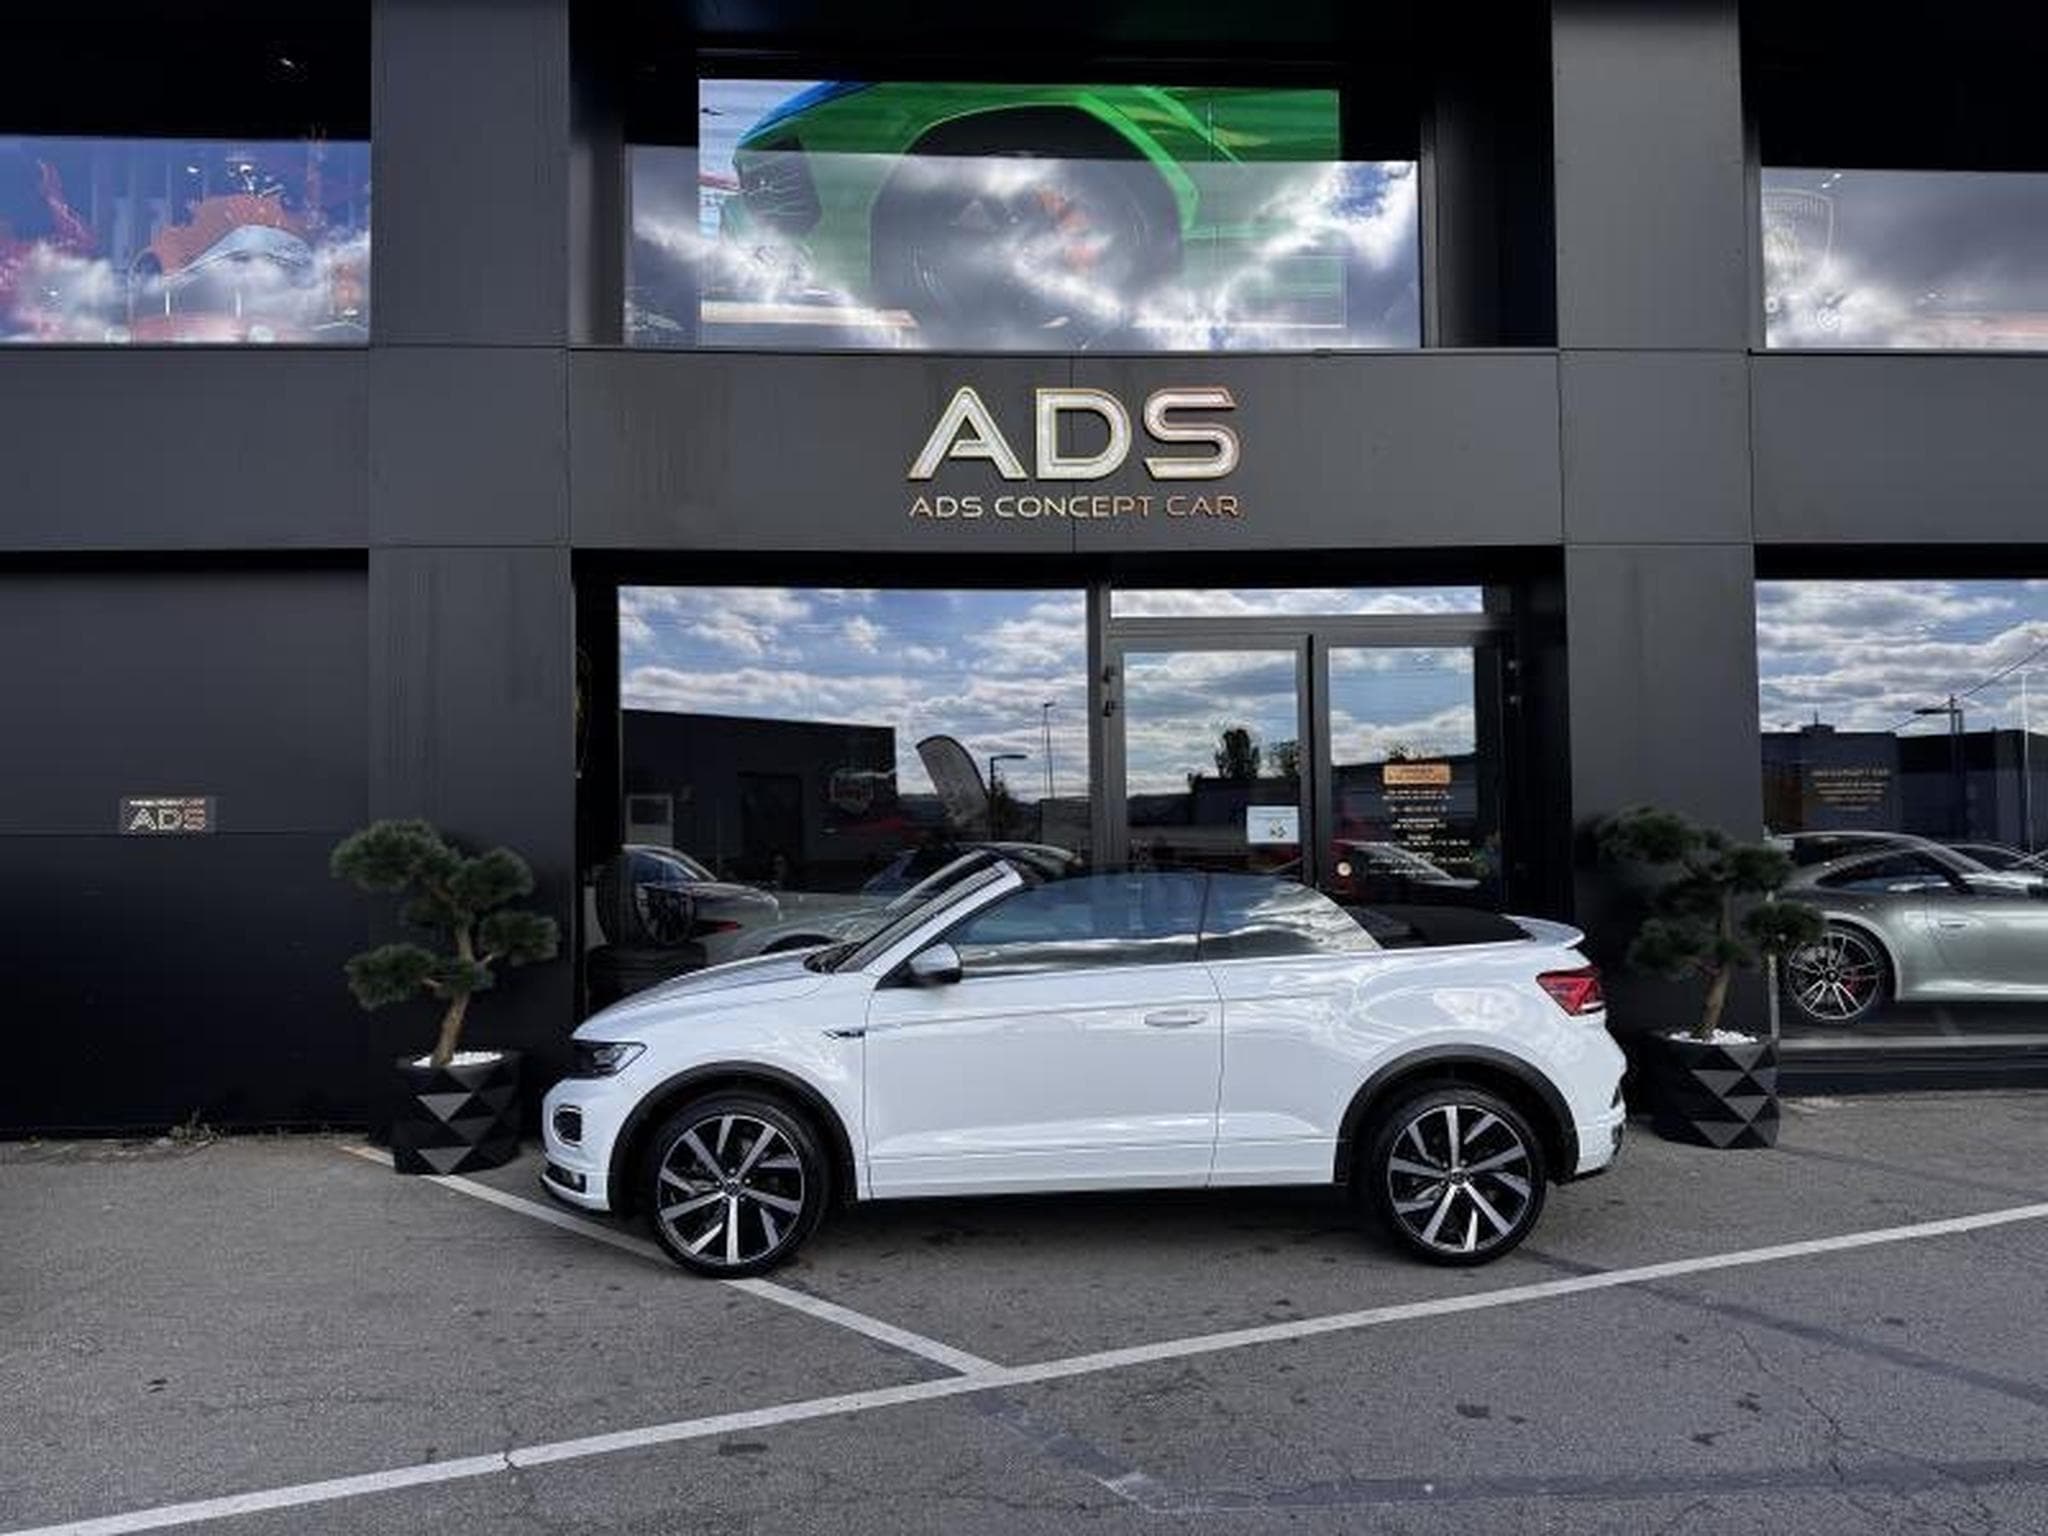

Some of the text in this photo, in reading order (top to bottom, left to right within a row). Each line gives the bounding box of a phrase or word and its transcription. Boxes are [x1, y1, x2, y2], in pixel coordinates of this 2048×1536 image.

[908, 386, 1240, 480] ADS
[909, 496, 1240, 518] ADS CONCEPT CAR
[129, 808, 206, 830] ADS
